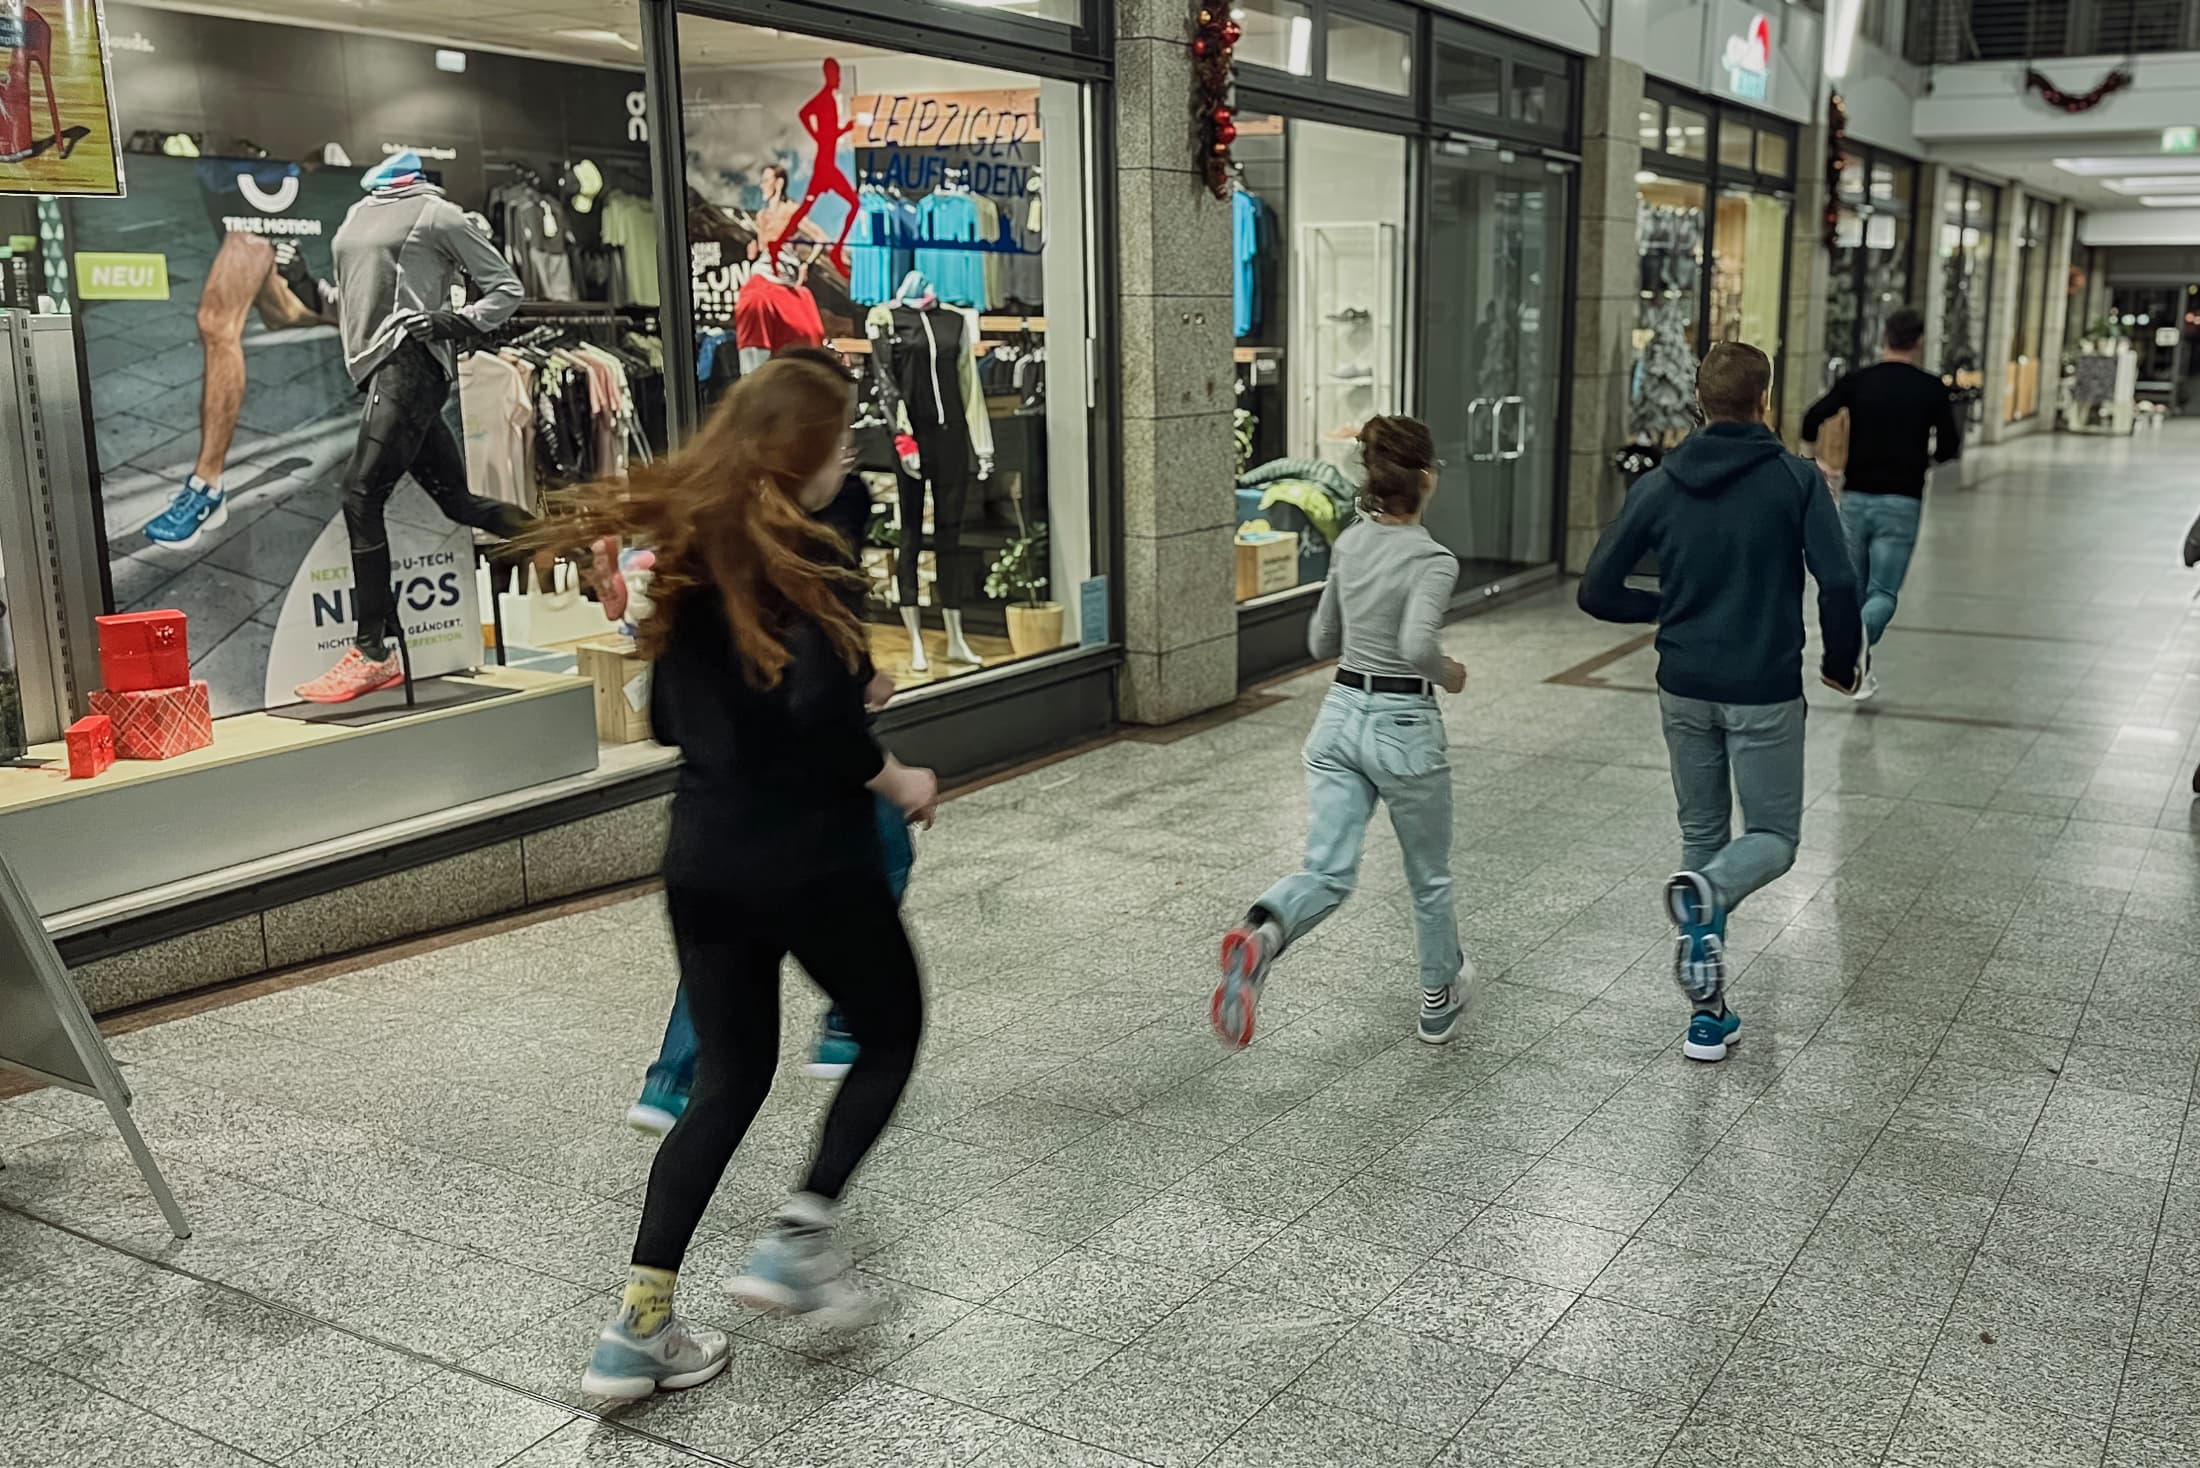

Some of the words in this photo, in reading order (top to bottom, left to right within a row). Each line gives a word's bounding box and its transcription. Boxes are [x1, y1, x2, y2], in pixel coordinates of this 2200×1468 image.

[867, 93, 1031, 162] LEIPZIGER
[865, 150, 1028, 197] LAUFLADEN
[222, 216, 263, 233] TRUE
[263, 218, 321, 235] MOTION
[91, 265, 154, 288] NEU!
[310, 566, 348, 582] NEXT
[403, 552, 454, 569] U-TECH
